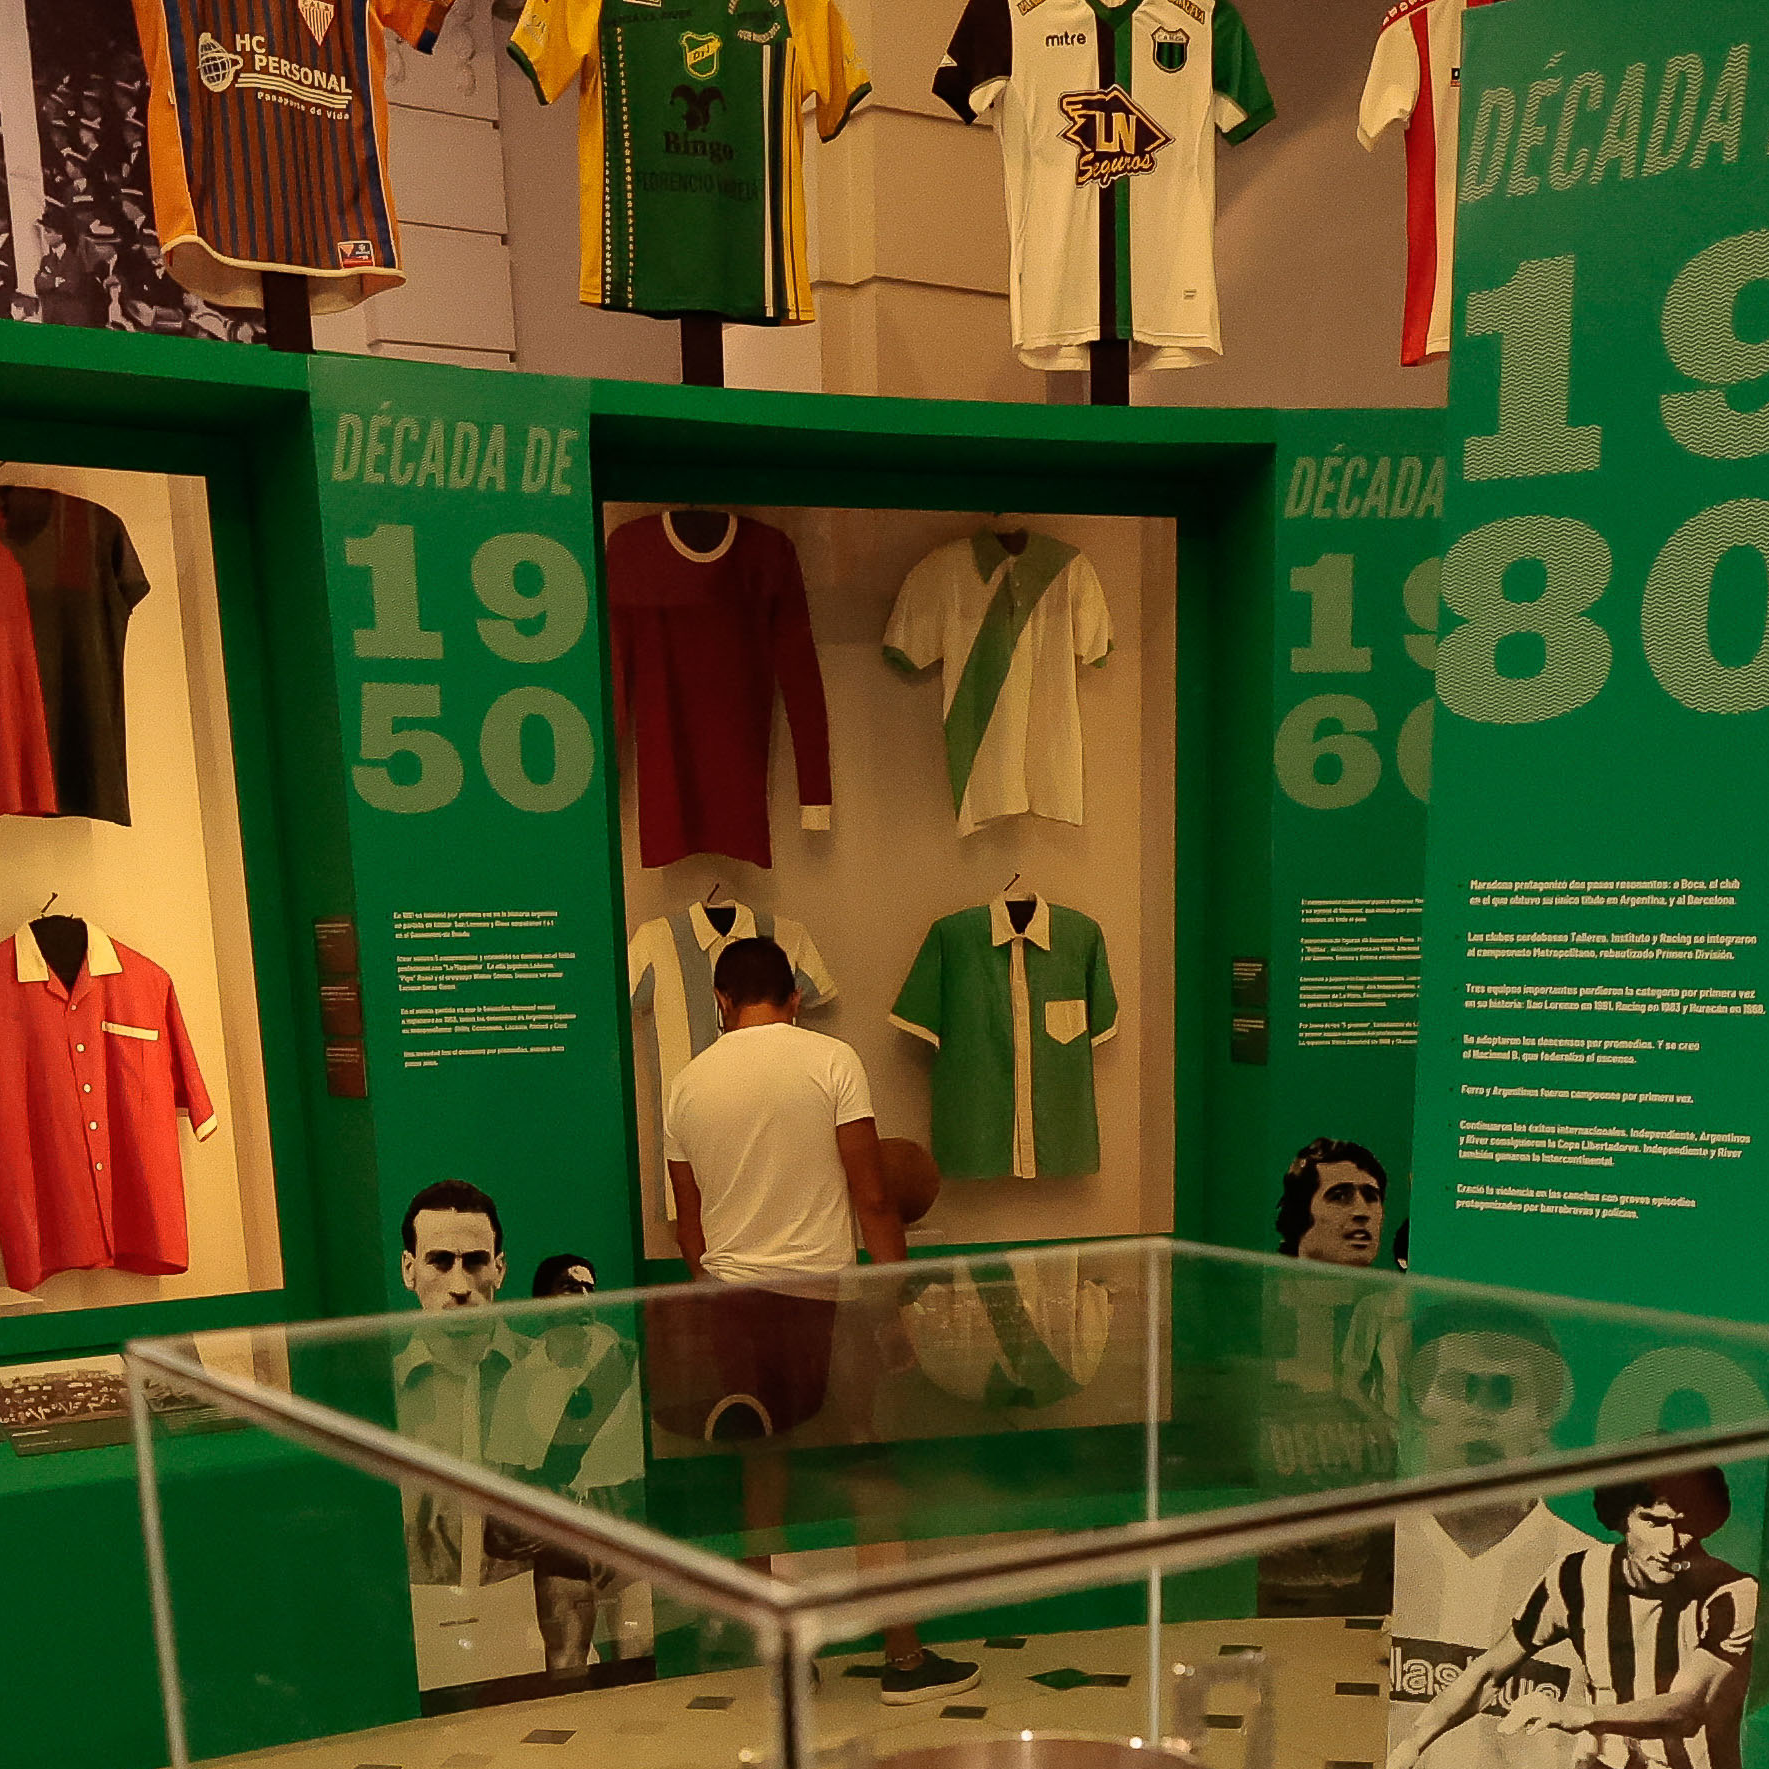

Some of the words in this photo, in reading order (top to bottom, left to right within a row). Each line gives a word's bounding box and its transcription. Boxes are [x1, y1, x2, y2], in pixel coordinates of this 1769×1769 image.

[235, 33, 266, 53] HC
[1045, 31, 1087, 48] mitre
[254, 54, 353, 94] PERSONAL
[665, 131, 734, 163] Bingo
[1459, 52, 1751, 204] DÉCADA
[1076, 152, 1153, 184] Seguros
[331, 401, 506, 493] DÉCADA
[521, 426, 580, 496] DE
[1283, 444, 1445, 521] DÉCADA
[344, 524, 589, 664] 19
[351, 681, 595, 814] 50
[1699, 988, 1736, 999] primera
[1738, 990, 1755, 999] vez
